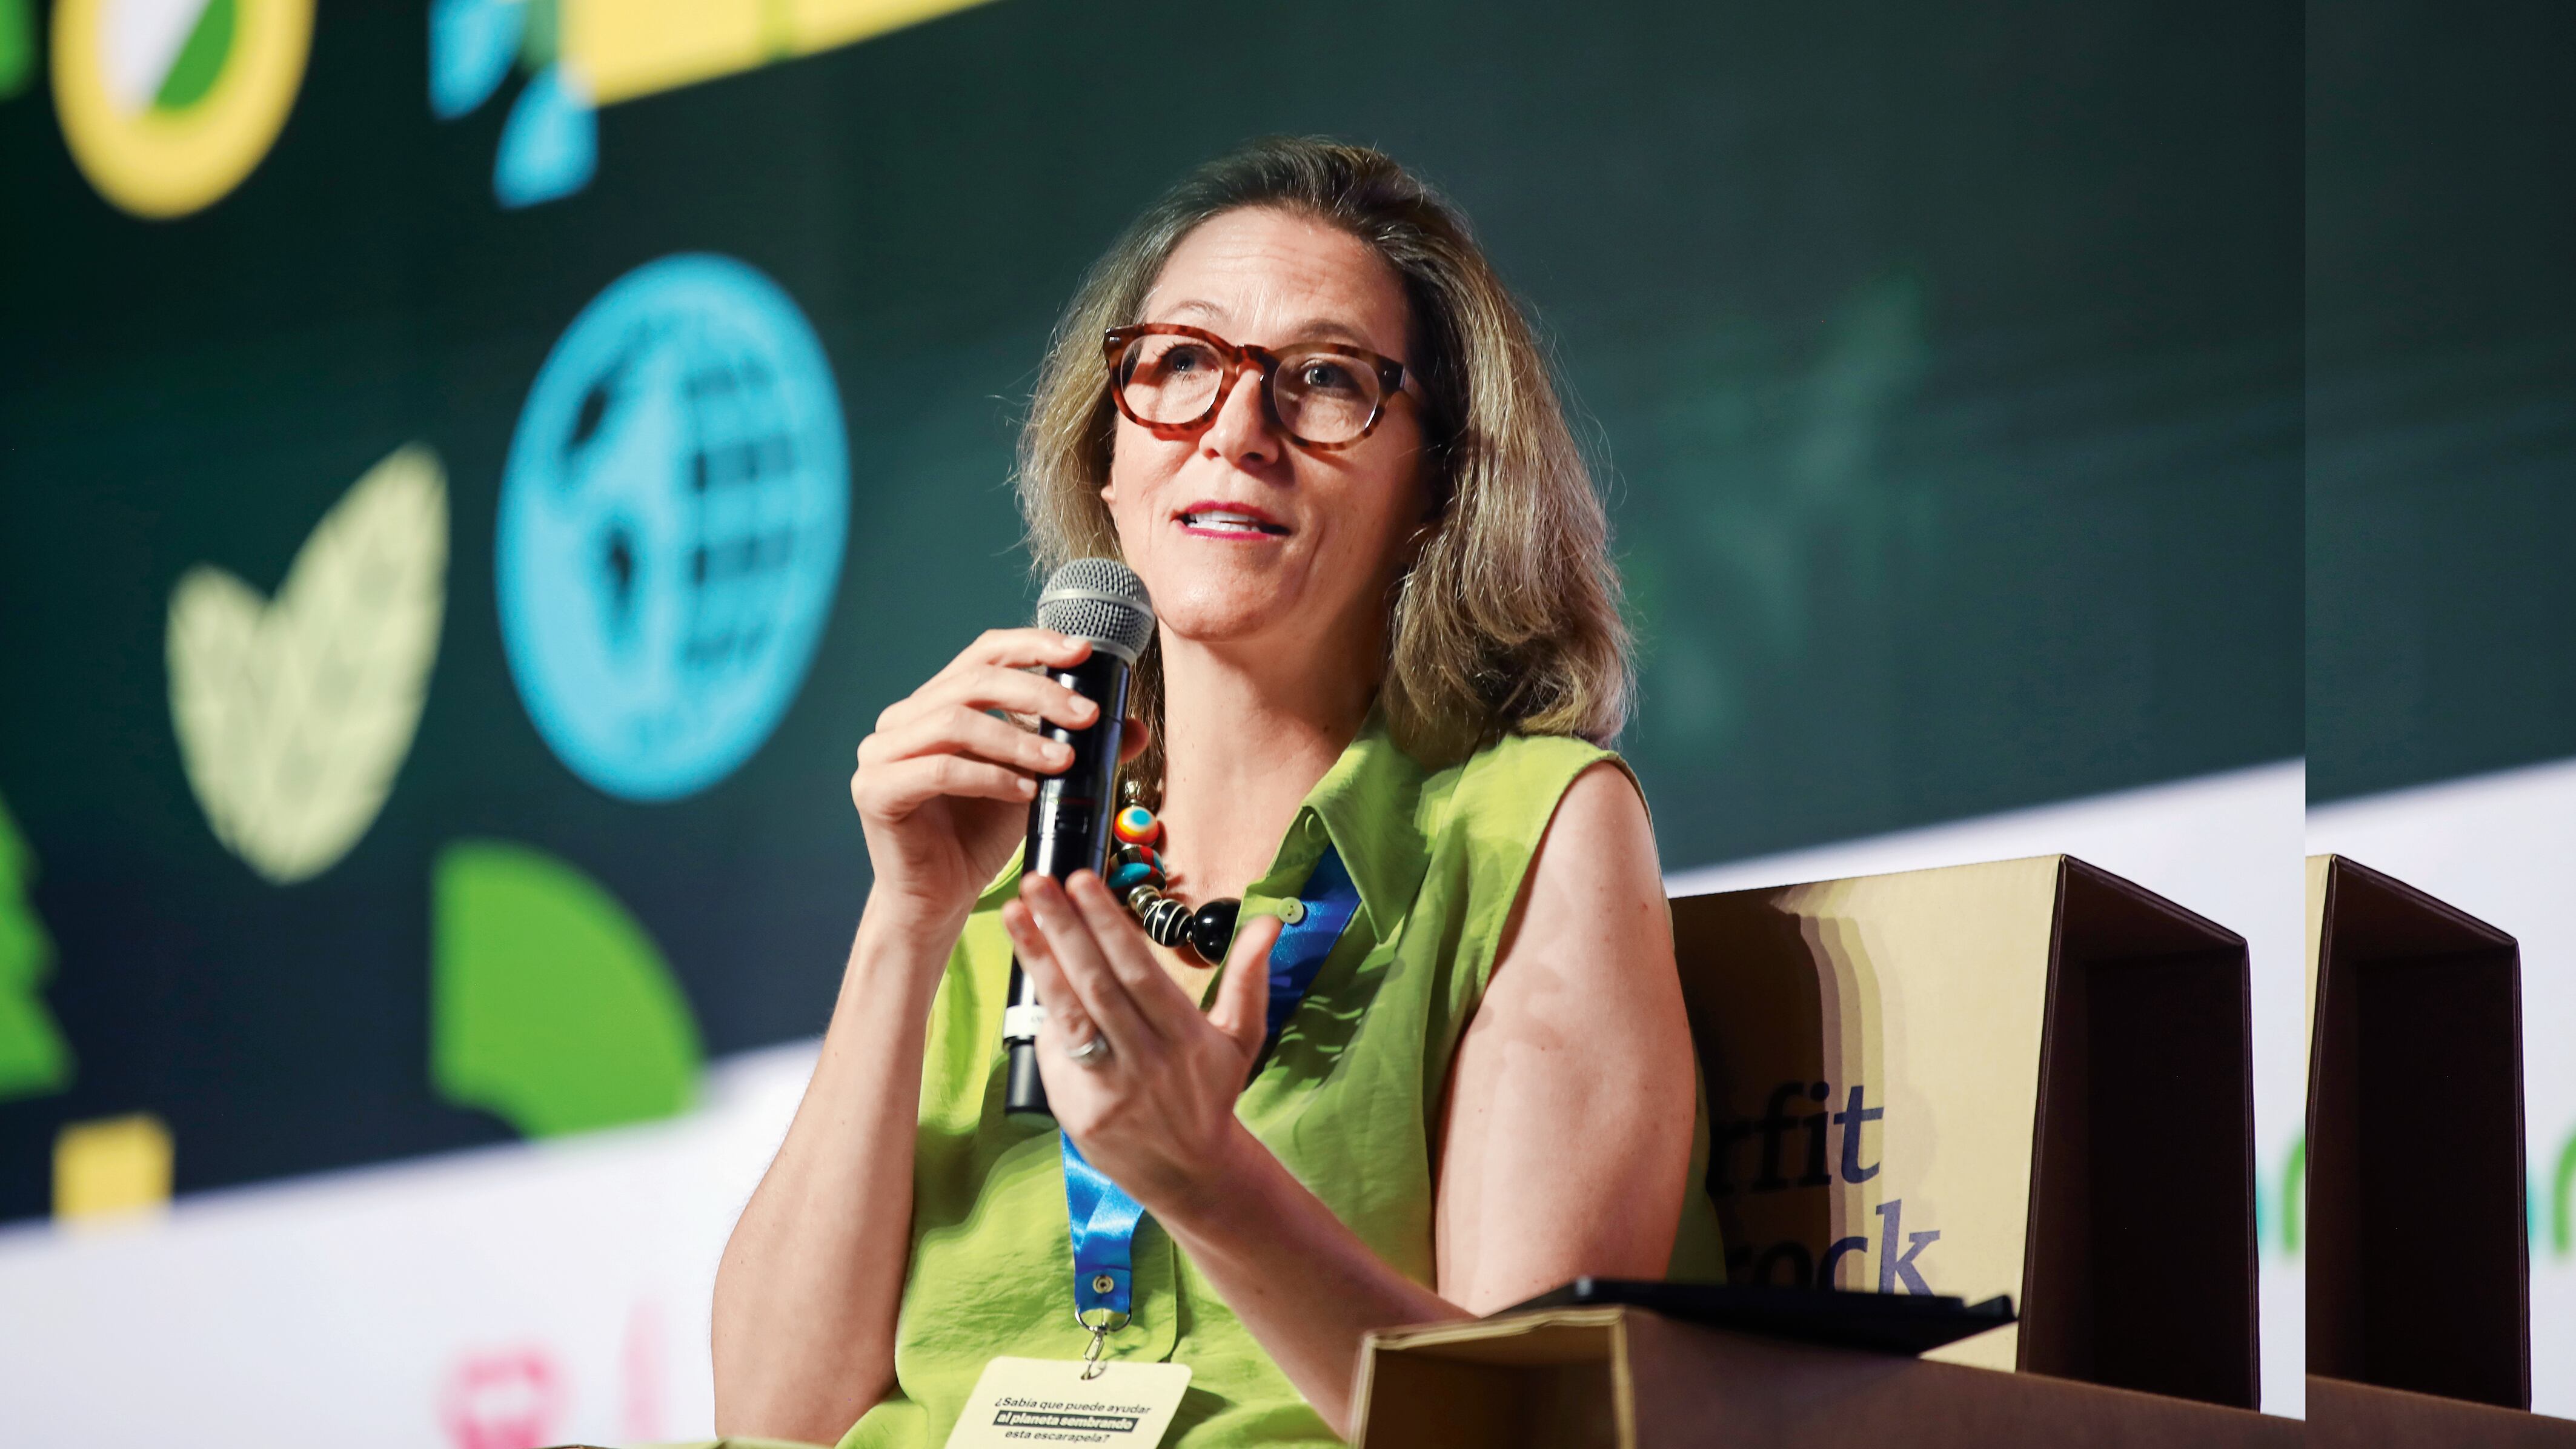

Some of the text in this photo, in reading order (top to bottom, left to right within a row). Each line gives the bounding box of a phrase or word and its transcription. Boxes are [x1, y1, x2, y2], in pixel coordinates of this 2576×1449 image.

[1040, 1401, 1063, 1410] que
[1064, 1402, 1104, 1412] puede
[1107, 1404, 1151, 1414] ayudar
[997, 1412, 1133, 1430] al planeta sembrando
[1005, 1430, 1110, 1444] esta escarapela?
